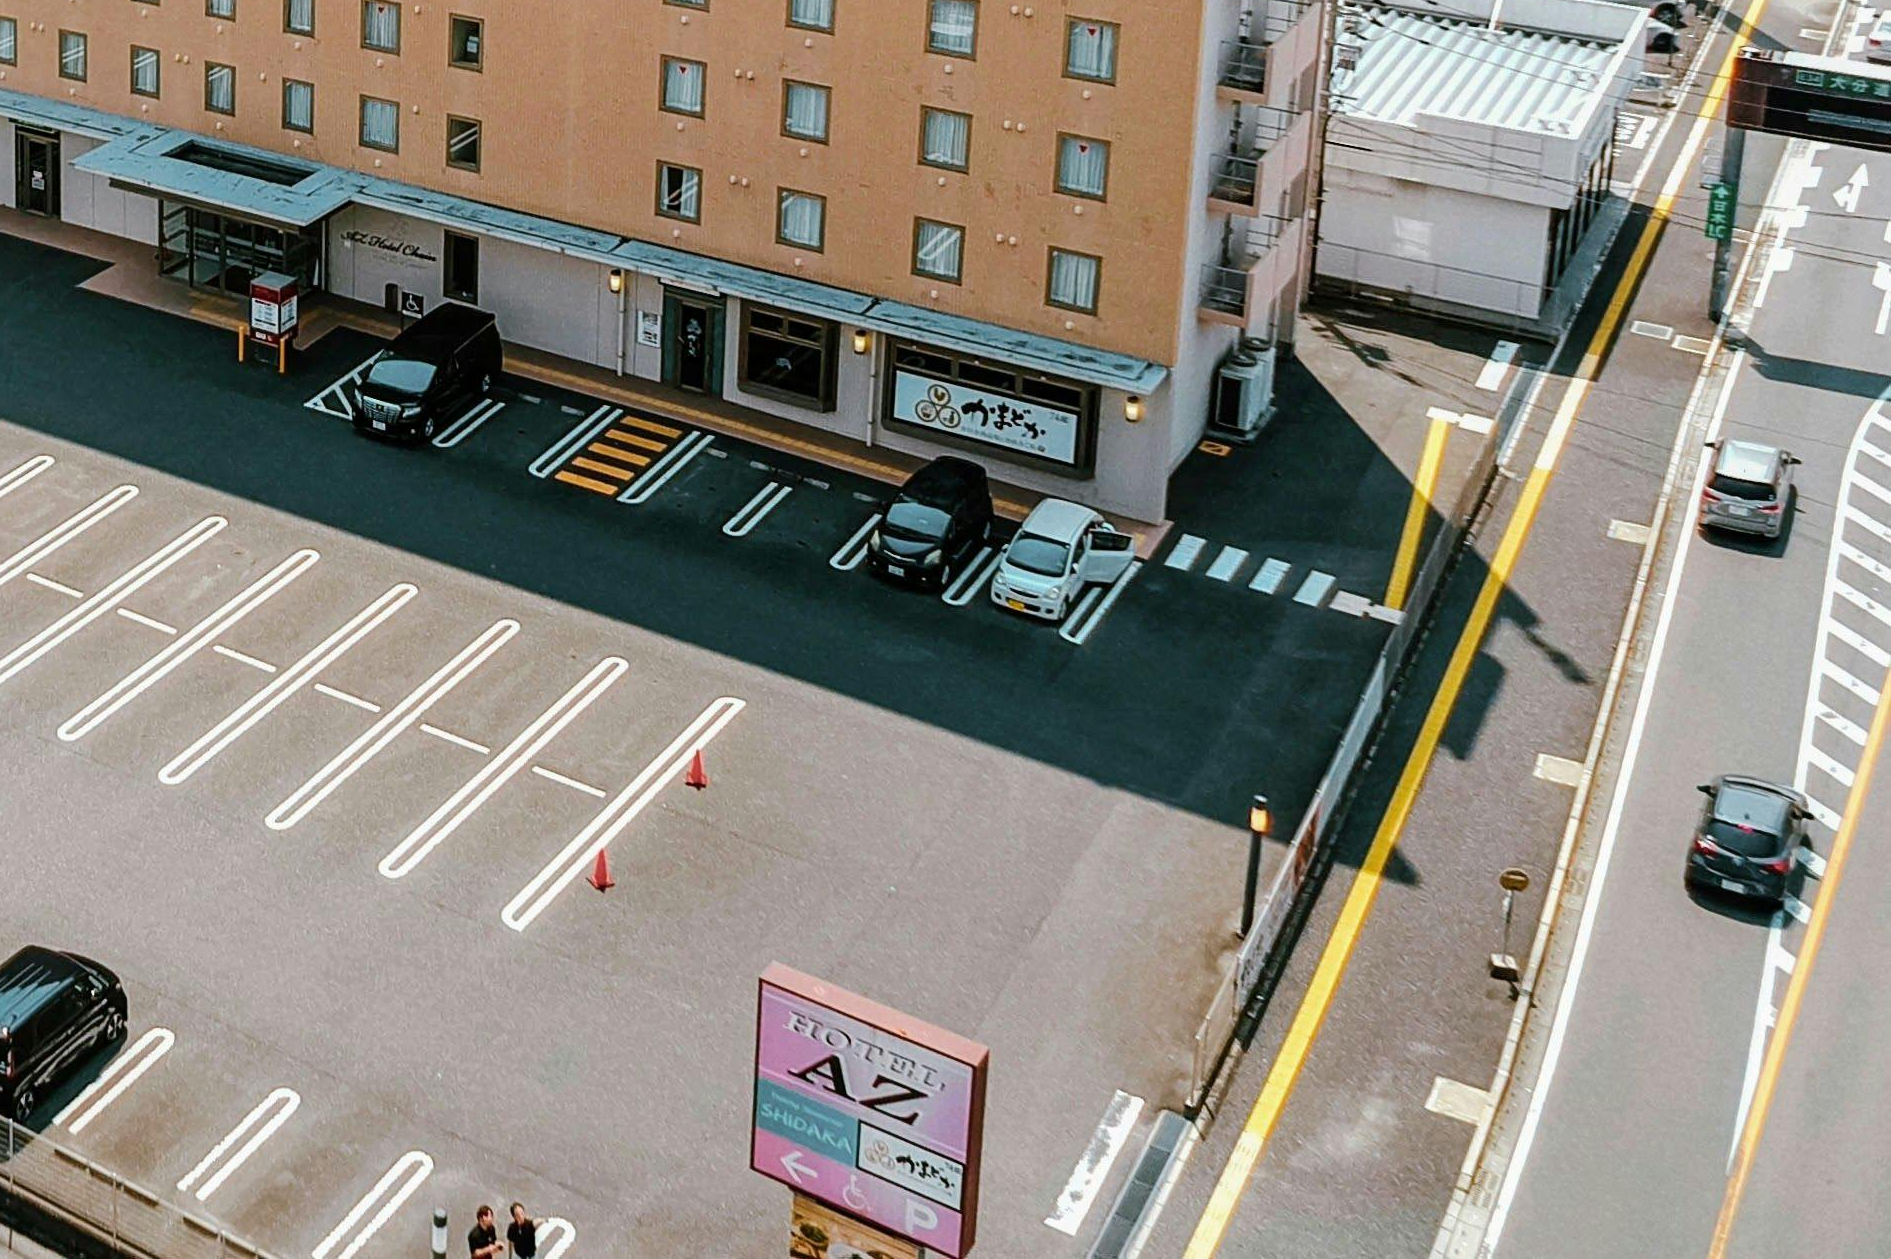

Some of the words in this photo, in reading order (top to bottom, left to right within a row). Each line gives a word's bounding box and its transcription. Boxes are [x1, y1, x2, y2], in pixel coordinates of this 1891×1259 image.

[961, 398, 1046, 439] かまどか
[782, 1011, 946, 1092] HOTEL
[787, 1053, 929, 1126] AZ
[760, 1103, 853, 1156] SHIDAKA
